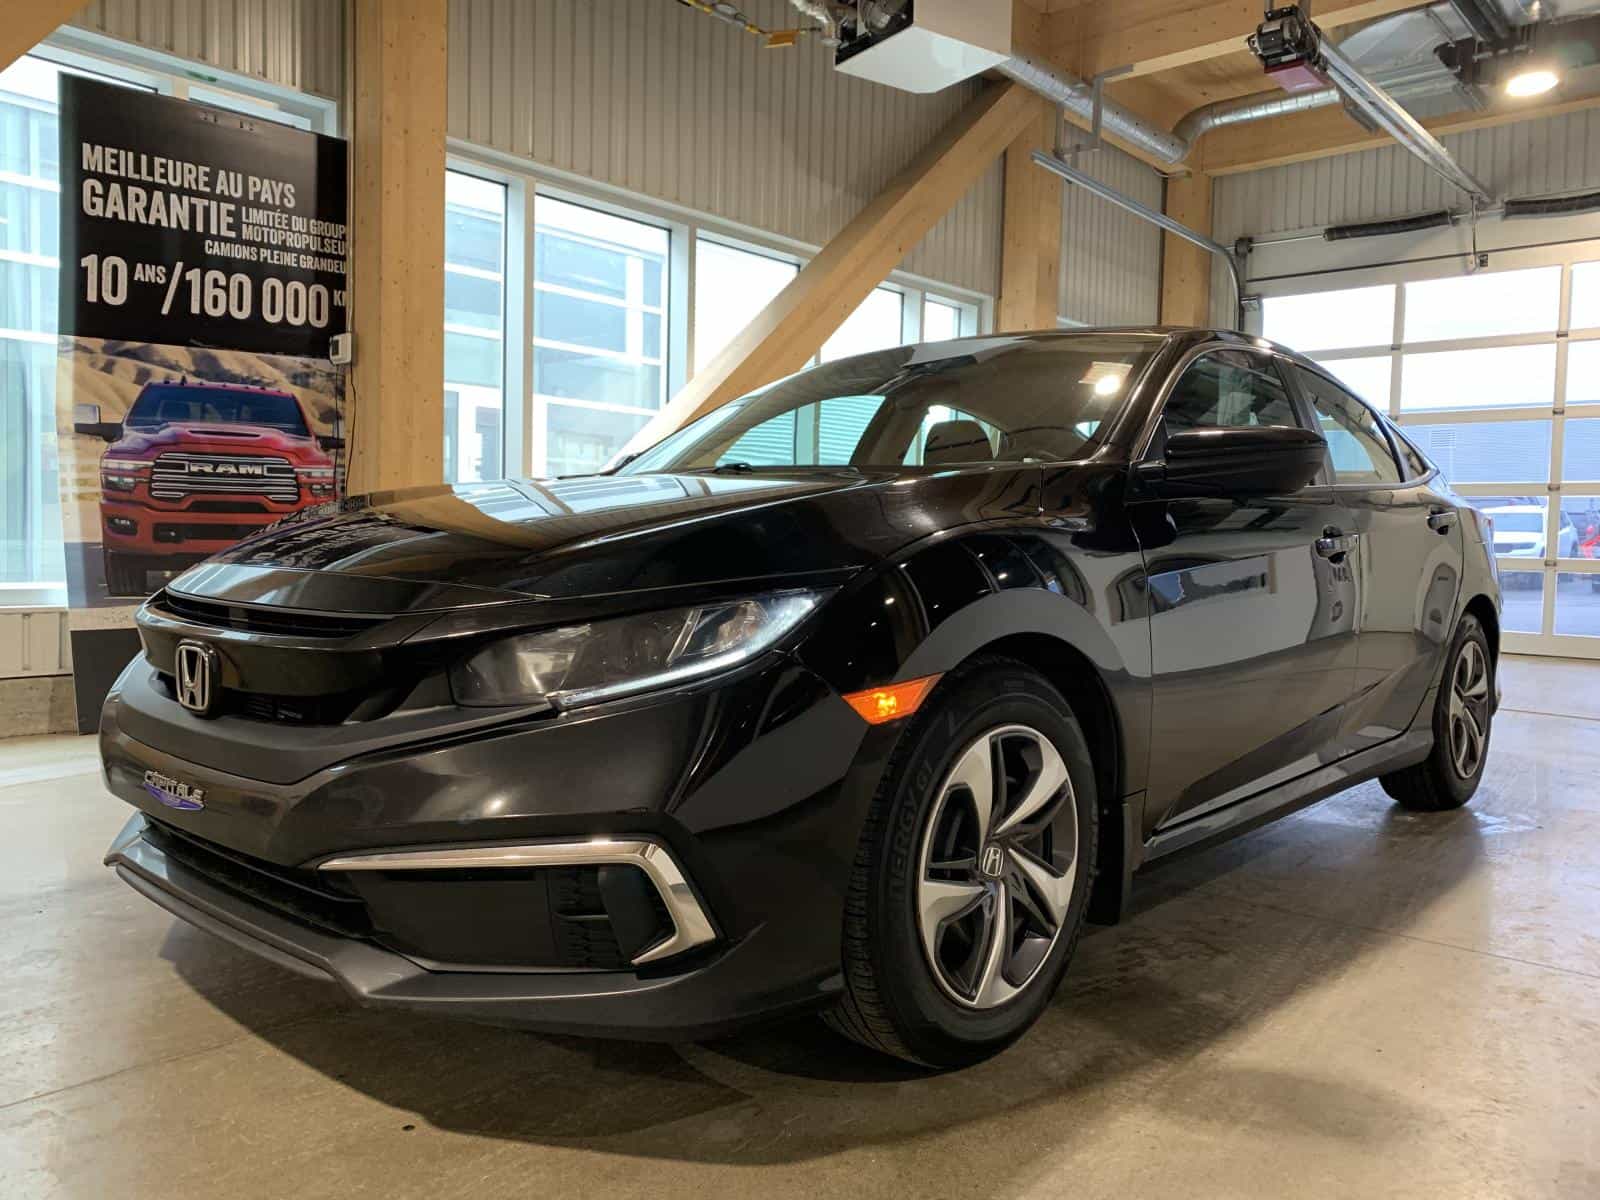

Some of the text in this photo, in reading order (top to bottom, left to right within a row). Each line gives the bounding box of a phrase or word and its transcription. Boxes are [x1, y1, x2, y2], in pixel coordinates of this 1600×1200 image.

[82, 142, 295, 208] MEILLEURE AU PAYS
[82, 178, 236, 238] GARANTIE
[242, 207, 288, 229] LIMITÉE
[292, 214, 307, 232] DU
[205, 240, 257, 262] CAMIONS
[259, 250, 298, 267] PLEINE
[80, 253, 127, 305] 10
[262, 277, 329, 328] 000
[188, 462, 263, 476] RAM
